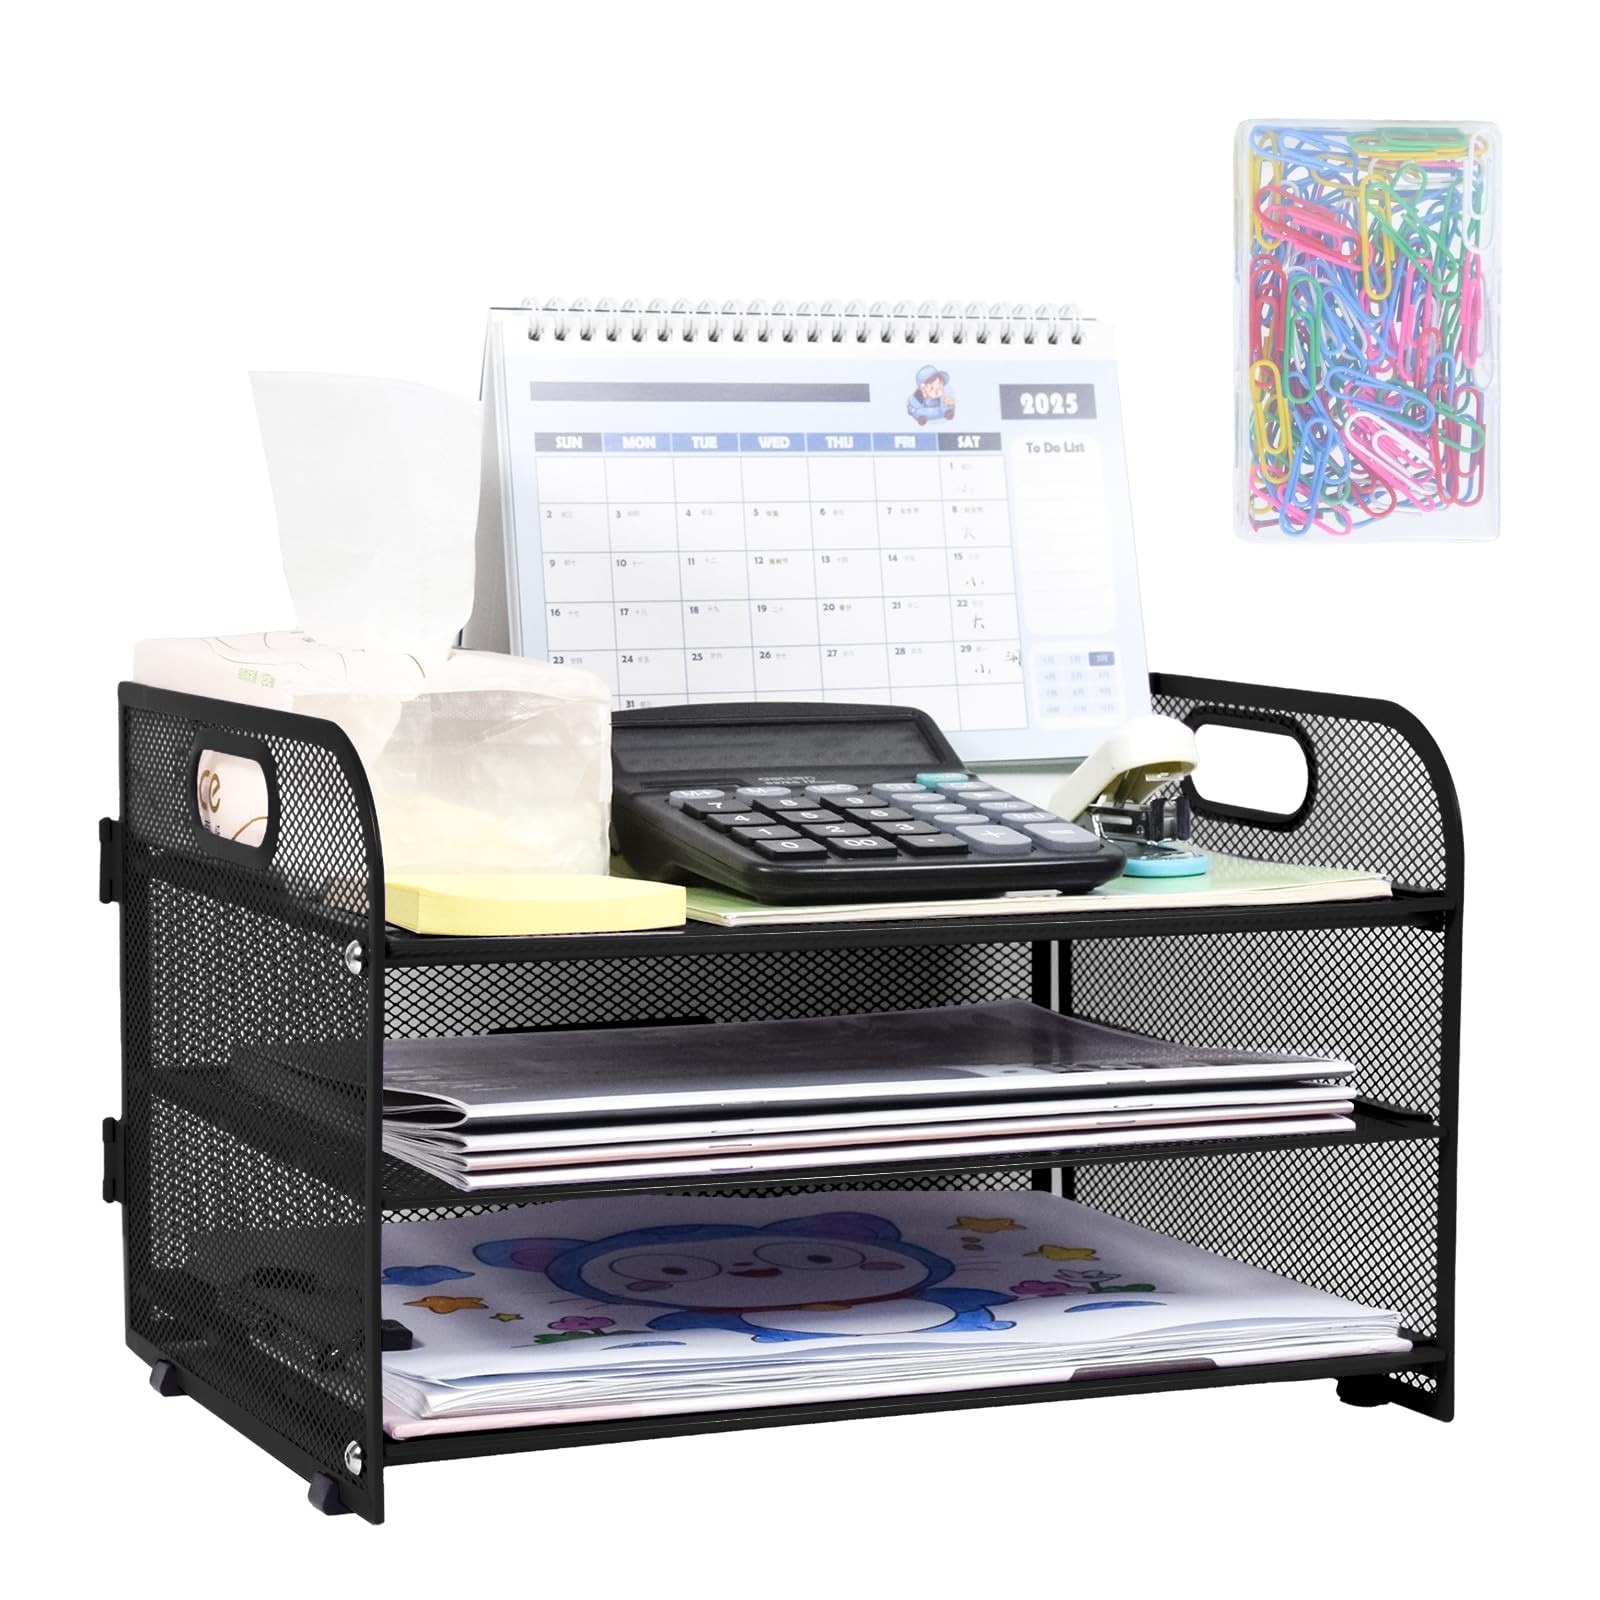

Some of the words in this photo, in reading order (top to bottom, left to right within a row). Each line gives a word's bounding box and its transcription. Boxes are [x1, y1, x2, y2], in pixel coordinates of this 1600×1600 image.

[1020, 392, 1079, 415] 2025
[555, 436, 583, 449] SUN
[622, 436, 656, 449] MON
[691, 436, 718, 449] TUE
[758, 436, 790, 448] WED
[825, 436, 854, 448] THU
[894, 435, 916, 448] FRI
[957, 435, 981, 448] SAT
[1026, 442, 1040, 454] To
[1043, 442, 1060, 454] Do
[1063, 442, 1085, 453] List
[546, 510, 552, 518] 2
[616, 510, 622, 518] 3
[685, 509, 691, 517] 4
[753, 508, 759, 517] 5
[820, 508, 826, 516] 6
[887, 507, 892, 515] 7
[688, 557, 695, 565] 11
[754, 556, 765, 565] 12
[821, 556, 831, 564] 13
[888, 554, 898, 562] 14
[549, 559, 555, 567] 9
[616, 559, 627, 567] 10
[690, 606, 699, 614] 18
[757, 605, 767, 613] 19
[823, 603, 835, 612] 20
[620, 608, 629, 616] 17
[827, 649, 837, 657] 27
[895, 647, 905, 655] 28
[960, 645, 972, 653] 29
[621, 655, 633, 663] 24
[692, 653, 703, 661] 25
[759, 651, 771, 659] 26
[553, 656, 564, 664] 23
[626, 700, 635, 708] 31
[779, 799, 798, 807] 8
[846, 796, 864, 805] 9
[870, 809, 889, 817] 6
[825, 825, 846, 833] 2
[895, 823, 914, 831] 3
[758, 828, 773, 836] 1
[781, 841, 799, 849] 0
[844, 838, 877, 847] 00
